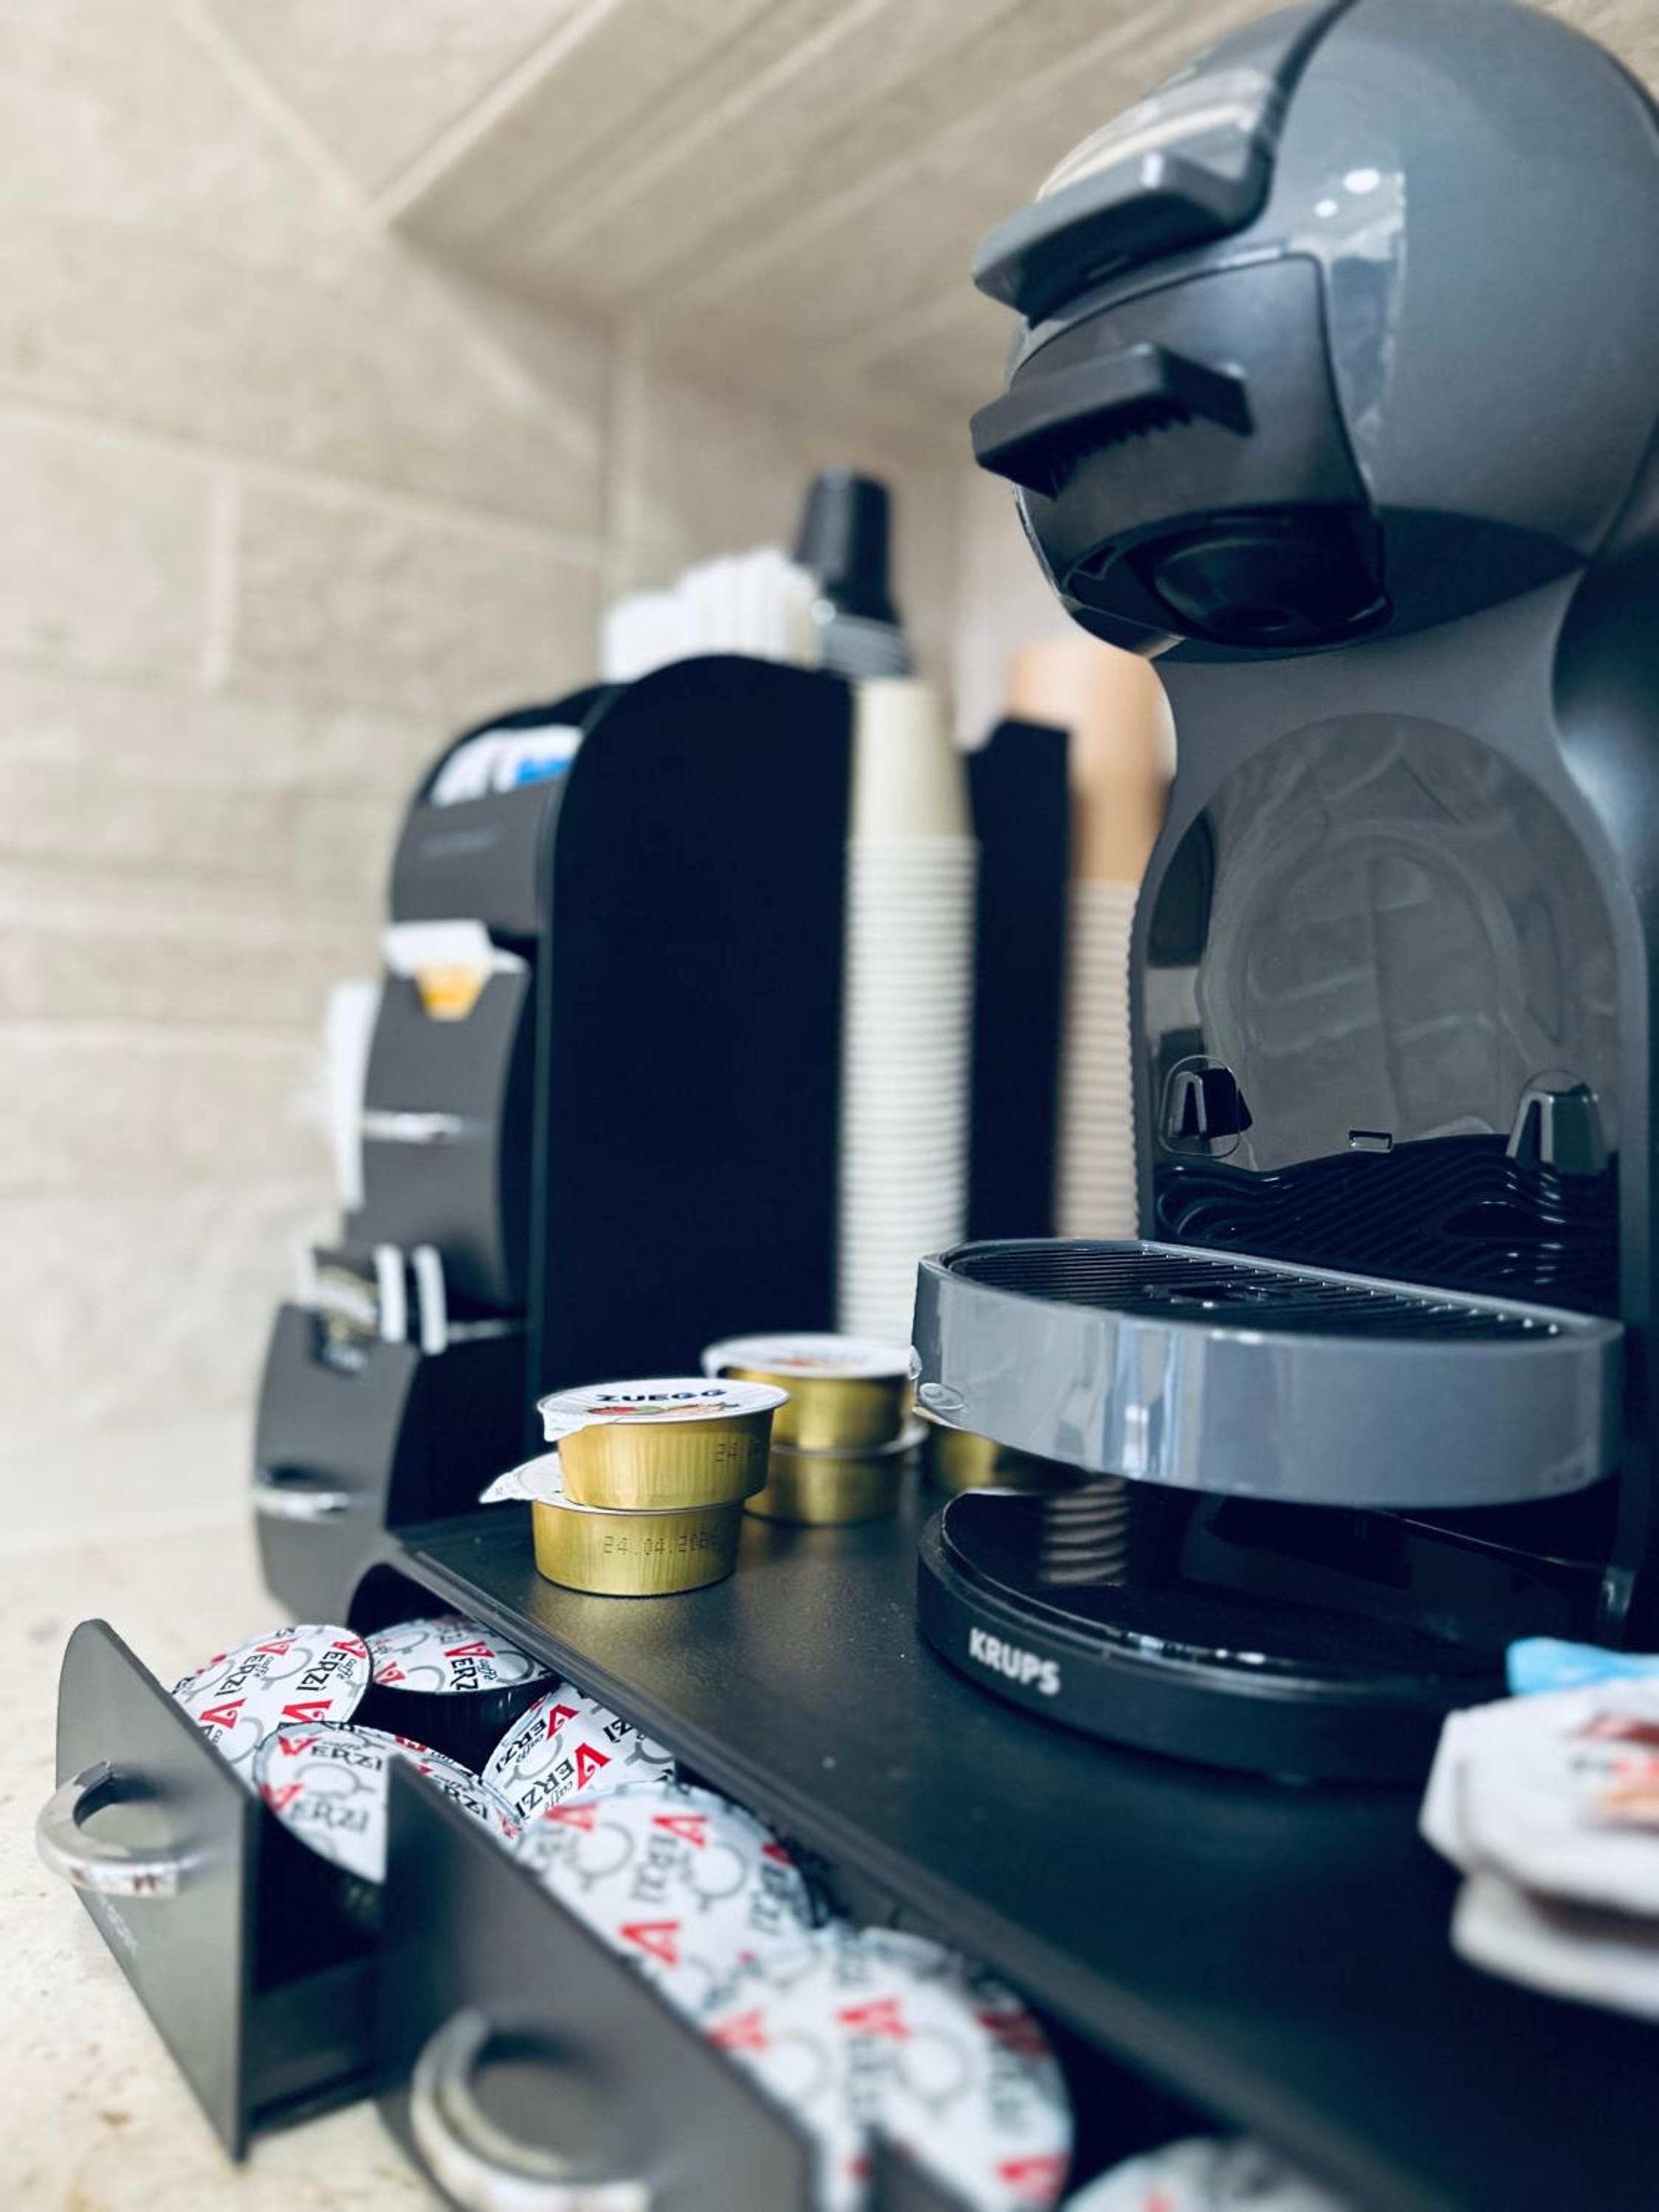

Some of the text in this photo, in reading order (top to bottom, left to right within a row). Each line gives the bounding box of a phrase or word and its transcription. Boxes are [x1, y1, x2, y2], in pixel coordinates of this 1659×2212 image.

[596, 1388, 726, 1401] ZUEGG
[444, 1640, 496, 1691] VERZ
[970, 1627, 1060, 1695] KRUPS
